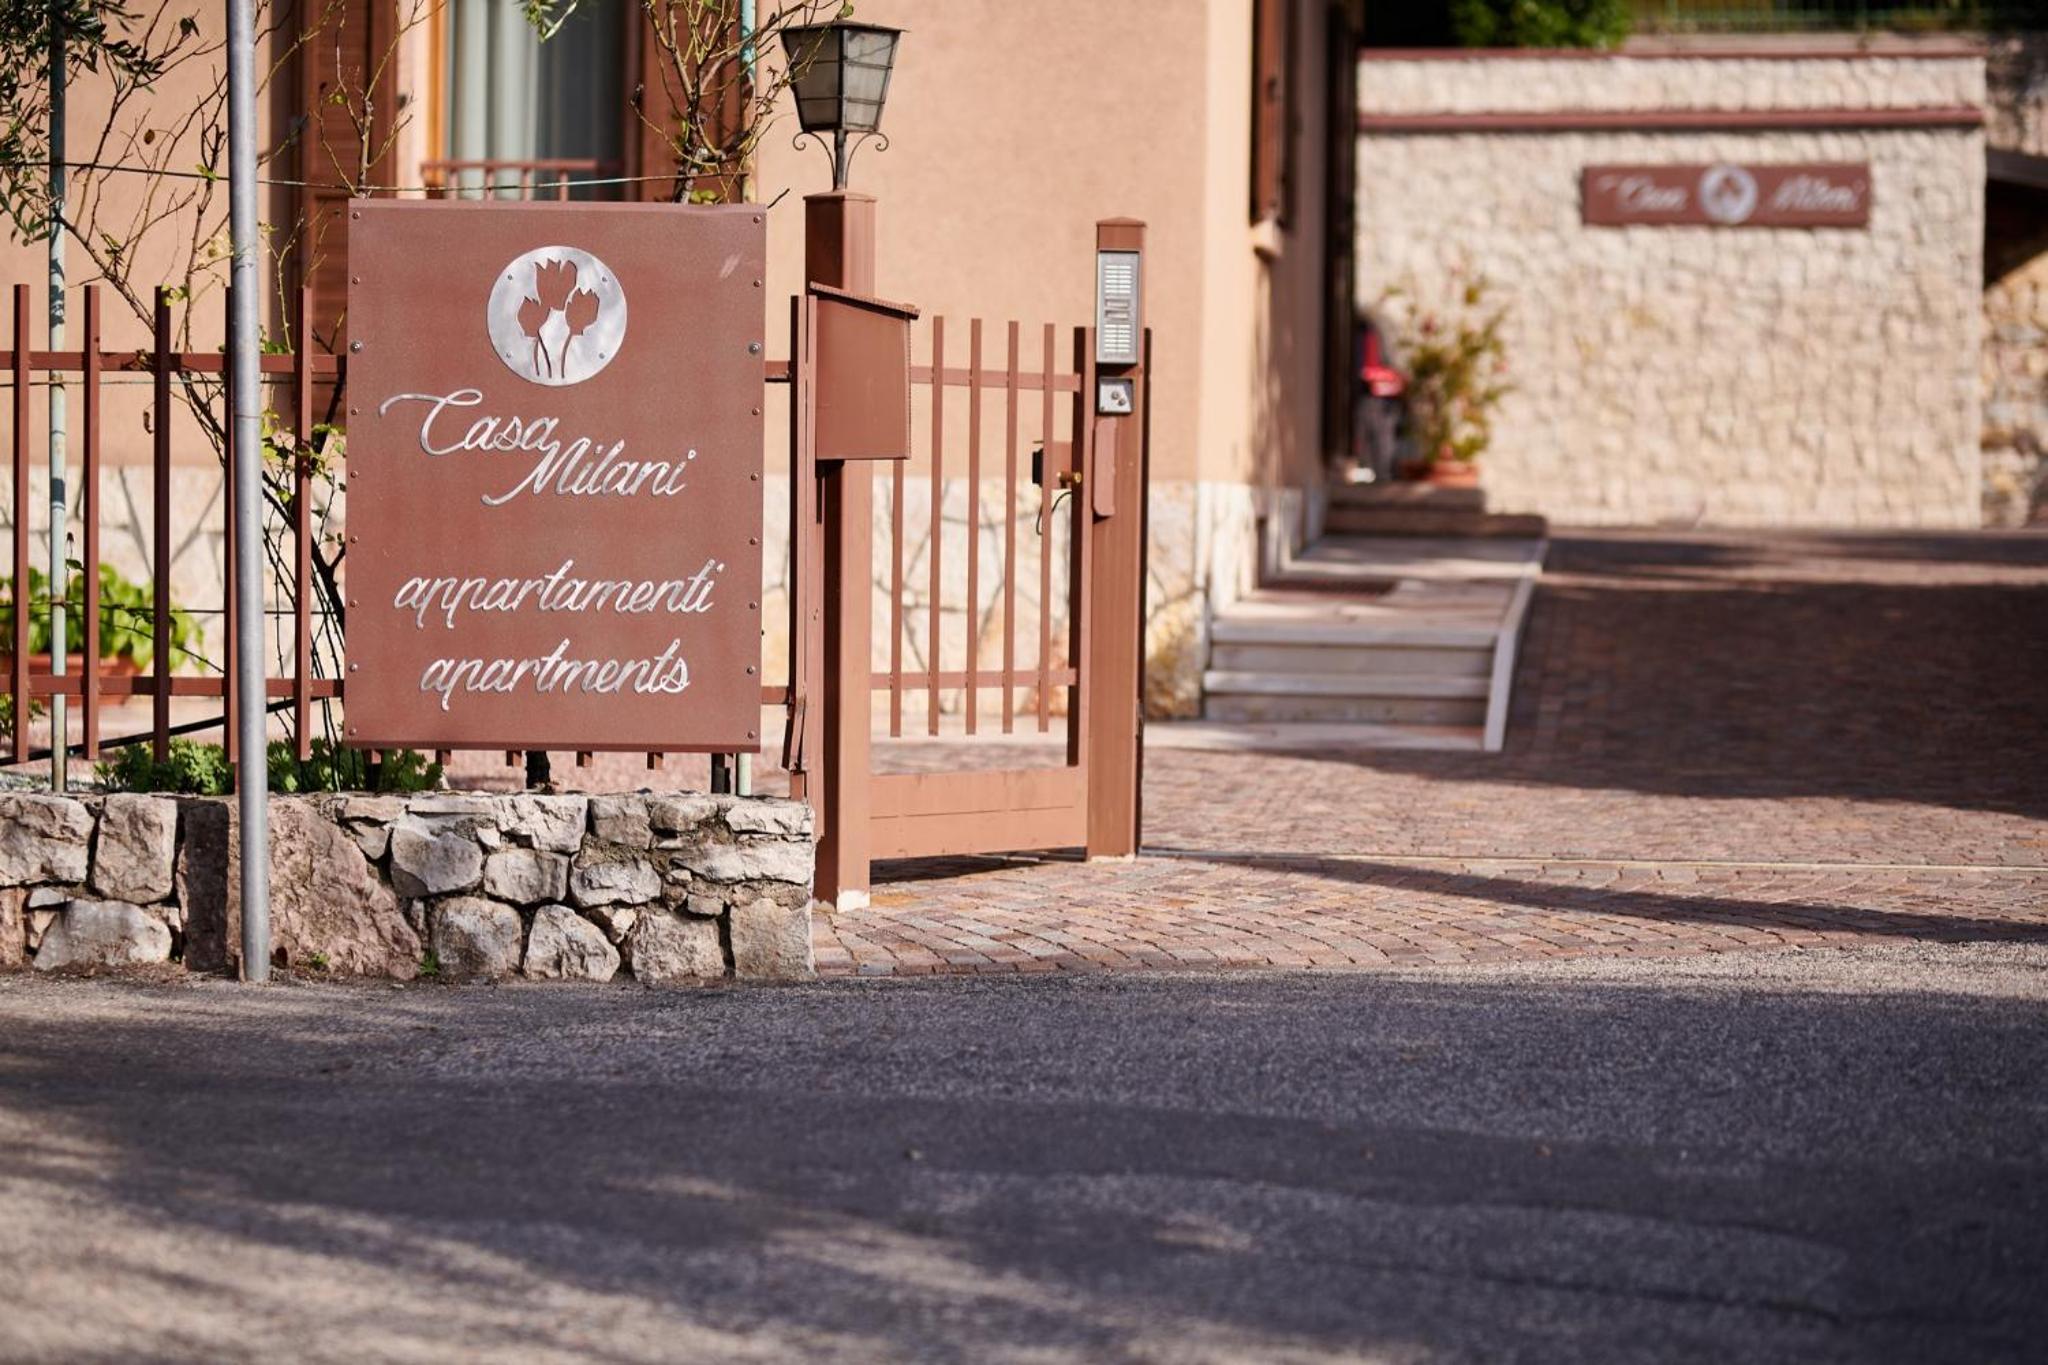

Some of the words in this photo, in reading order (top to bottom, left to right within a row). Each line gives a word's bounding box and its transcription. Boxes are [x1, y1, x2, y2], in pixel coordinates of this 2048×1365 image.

[379, 388, 560, 456] Casa
[481, 437, 697, 506] Milani
[393, 559, 726, 629] appartamenti
[420, 638, 691, 711] apartments
